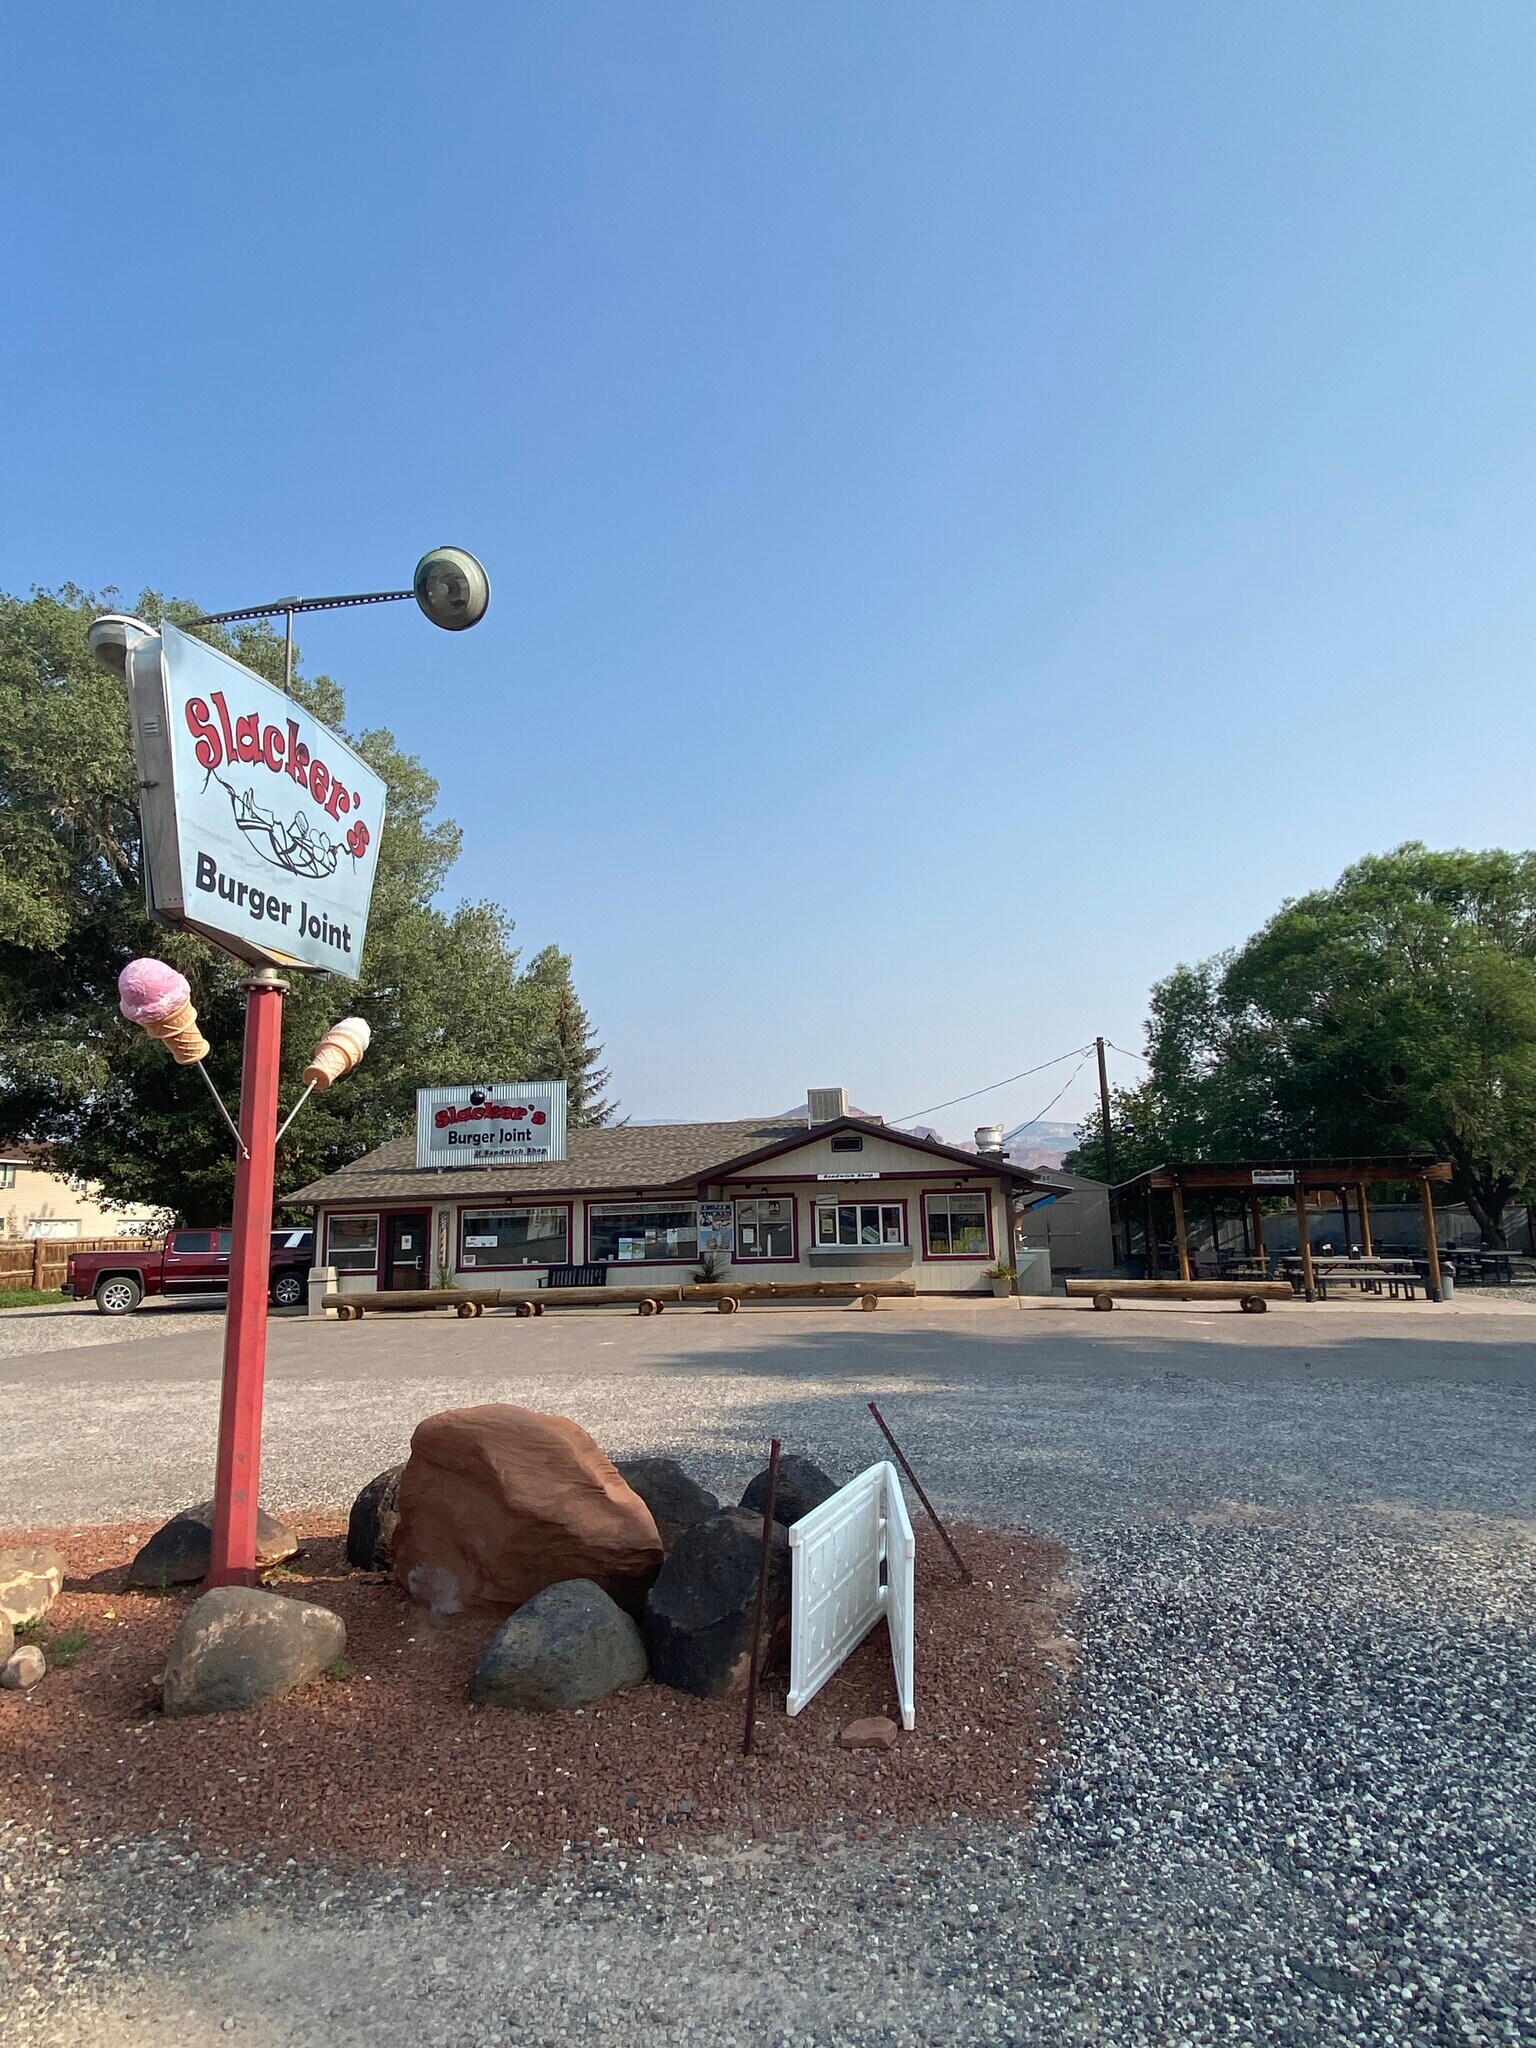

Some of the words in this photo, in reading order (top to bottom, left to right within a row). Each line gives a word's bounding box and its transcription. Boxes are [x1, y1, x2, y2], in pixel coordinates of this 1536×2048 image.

[185, 691, 370, 858] Slacker's
[196, 851, 292, 926] Burger
[300, 902, 351, 953] Joint
[434, 1102, 546, 1129] Slacker's
[448, 1130, 495, 1146] Burger
[499, 1128, 532, 1144] Joint
[484, 1148, 524, 1156] Sandwich
[526, 1147, 547, 1155] Shop
